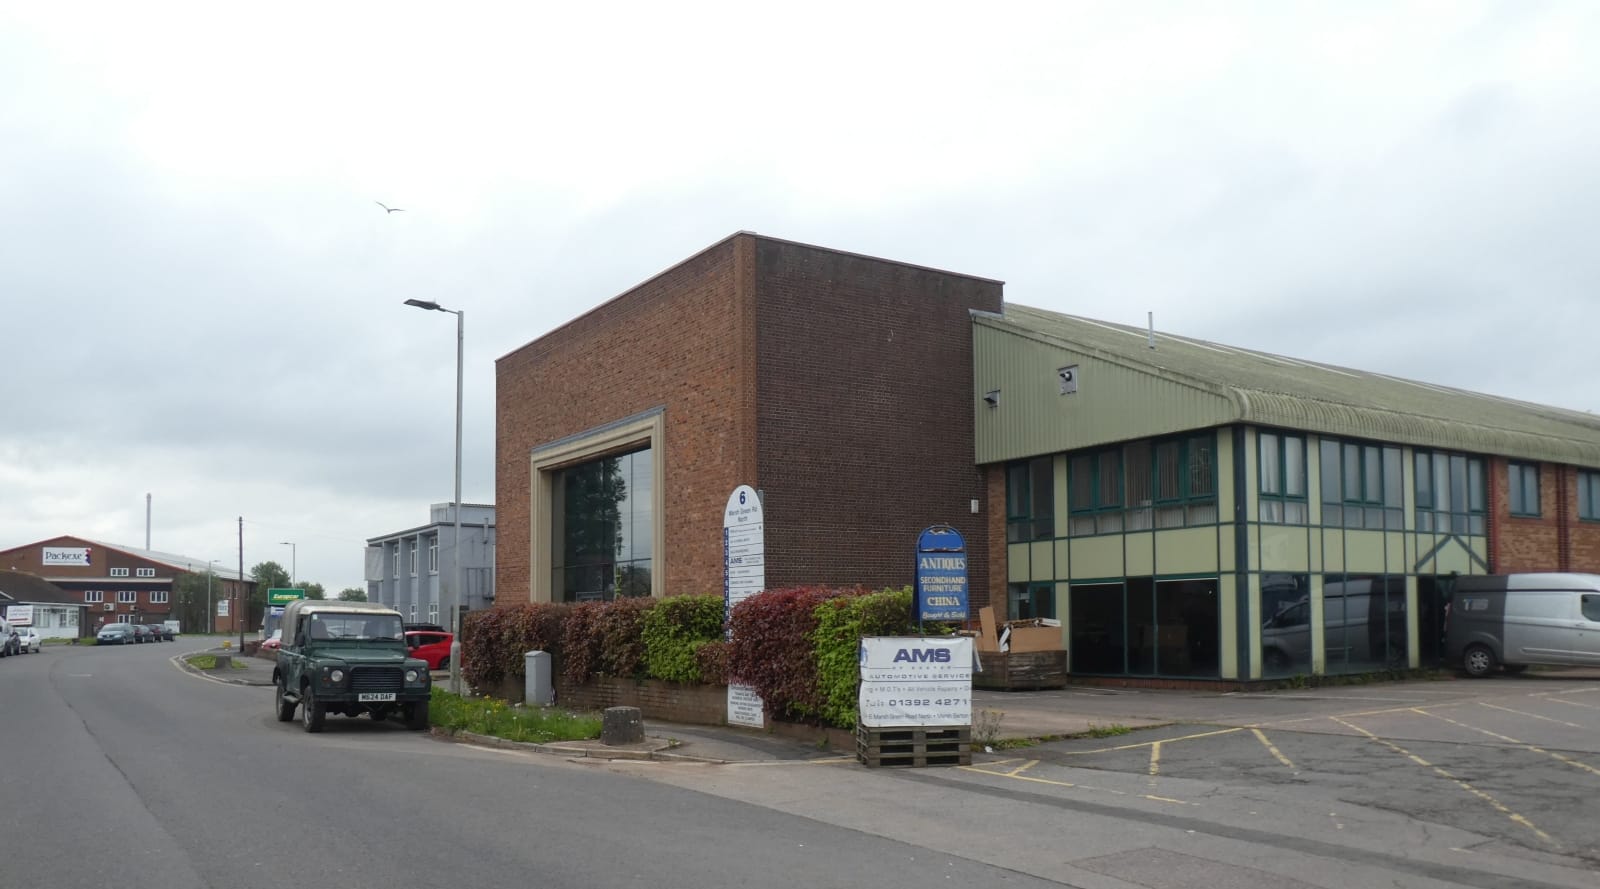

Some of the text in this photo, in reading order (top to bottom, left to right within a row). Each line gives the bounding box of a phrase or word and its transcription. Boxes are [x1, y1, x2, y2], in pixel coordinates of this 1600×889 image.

[739, 491, 746, 504] 6
[920, 558, 965, 570] ANTIQUES
[920, 576, 966, 584] SECONDHAND
[927, 596, 961, 606] CHINA
[893, 648, 951, 663] AMS
[888, 699, 930, 707] 01392
